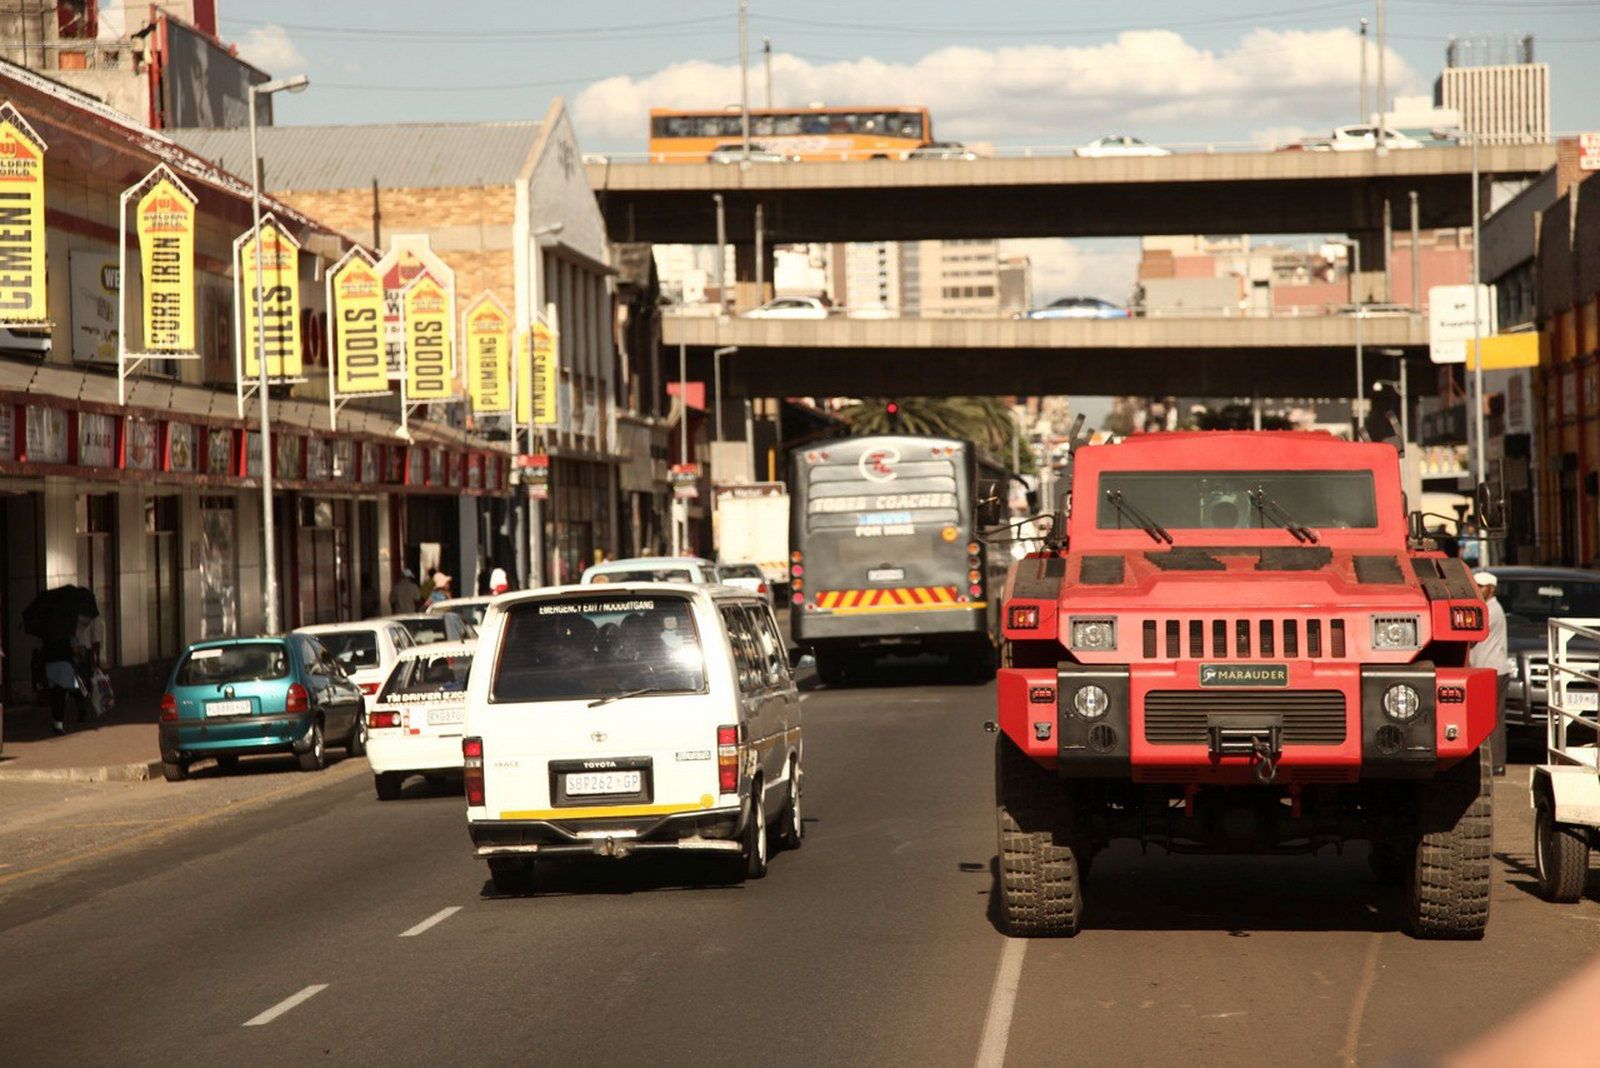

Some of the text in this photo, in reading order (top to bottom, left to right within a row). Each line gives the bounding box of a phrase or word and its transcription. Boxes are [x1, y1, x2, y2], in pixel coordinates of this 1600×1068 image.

[151, 238, 180, 343] CORR IRON
[252, 286, 293, 360] TILES
[345, 308, 379, 381] TOOLS
[414, 320, 443, 391] DOORS
[480, 337, 498, 405] PLUMBING
[532, 354, 546, 418] WINDOWS
[402, 692, 440, 702] DRIVER
[1218, 670, 1285, 680] MARAUDER
[583, 761, 617, 769] TOYOTA
